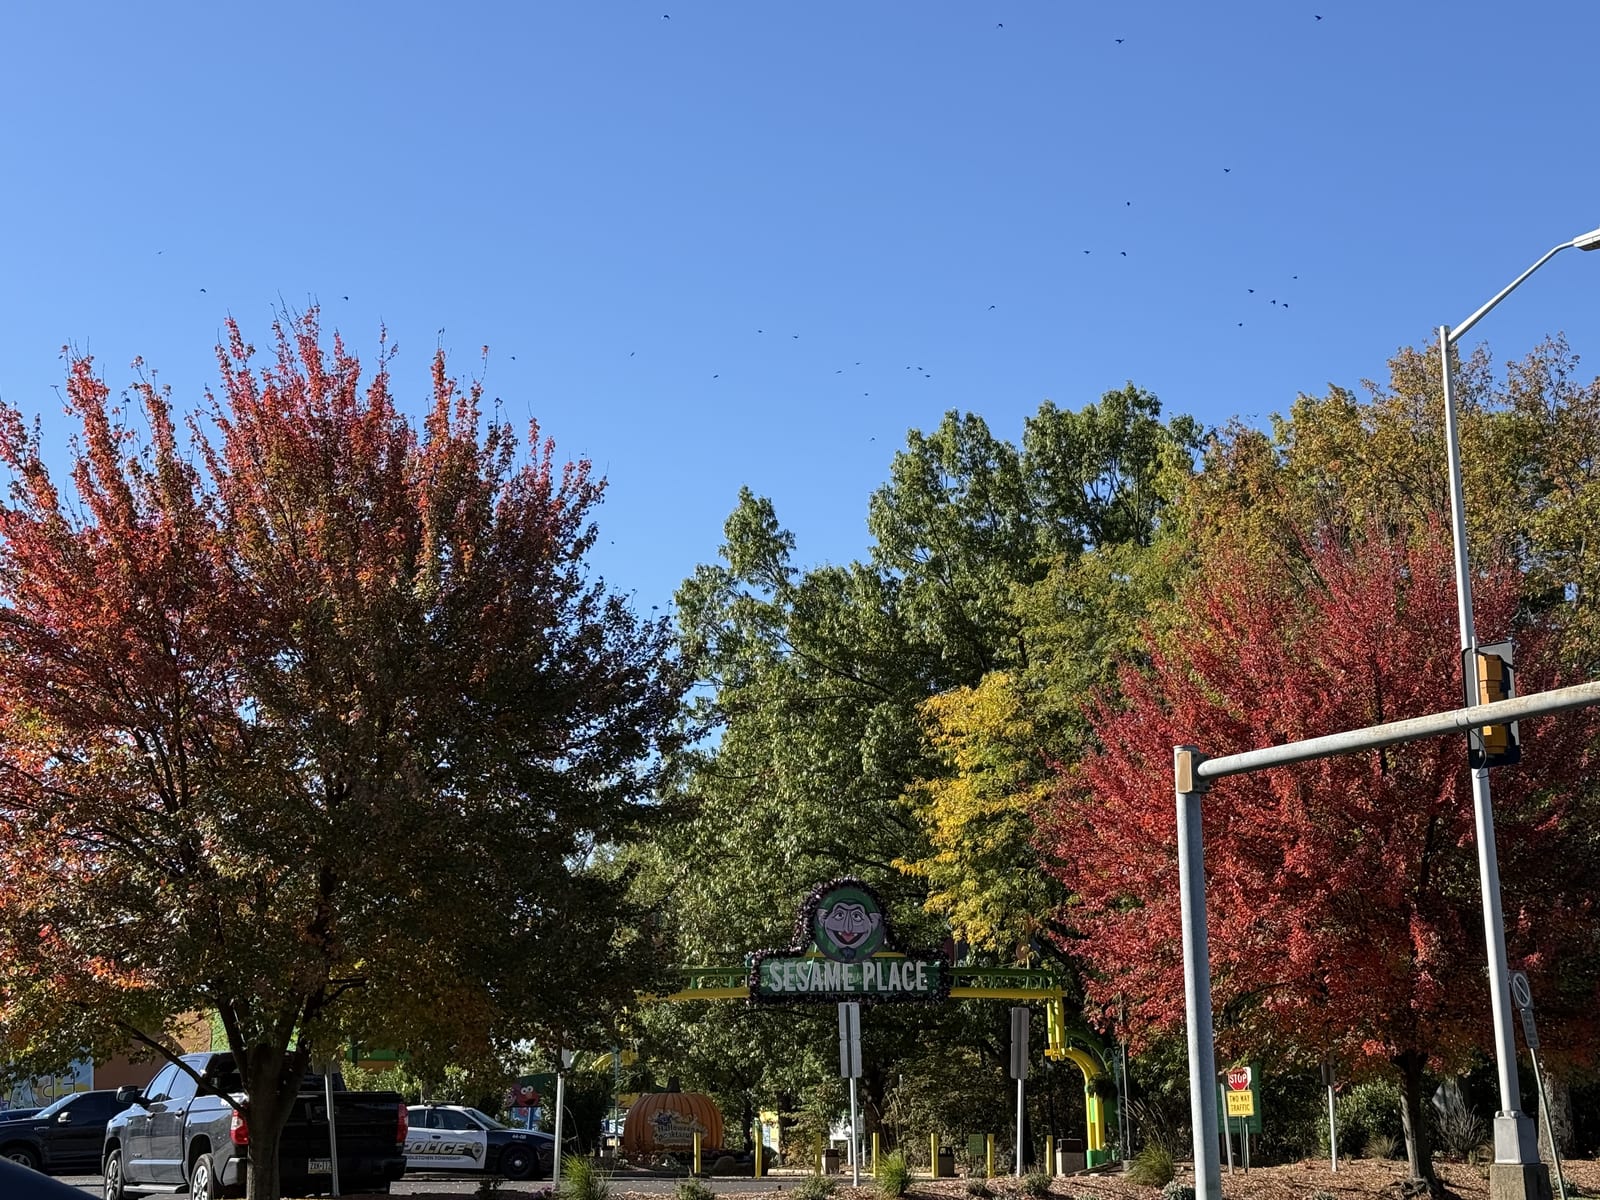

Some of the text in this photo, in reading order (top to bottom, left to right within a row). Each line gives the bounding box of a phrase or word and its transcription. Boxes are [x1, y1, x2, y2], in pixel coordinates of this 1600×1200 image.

[769, 960, 929, 992] SESAME PLACE
[1229, 1073, 1247, 1084] STOP
[1240, 1094, 1250, 1102] WAY
[1230, 1103, 1250, 1111] TRAFFIC
[404, 1141, 465, 1155] POLICE
